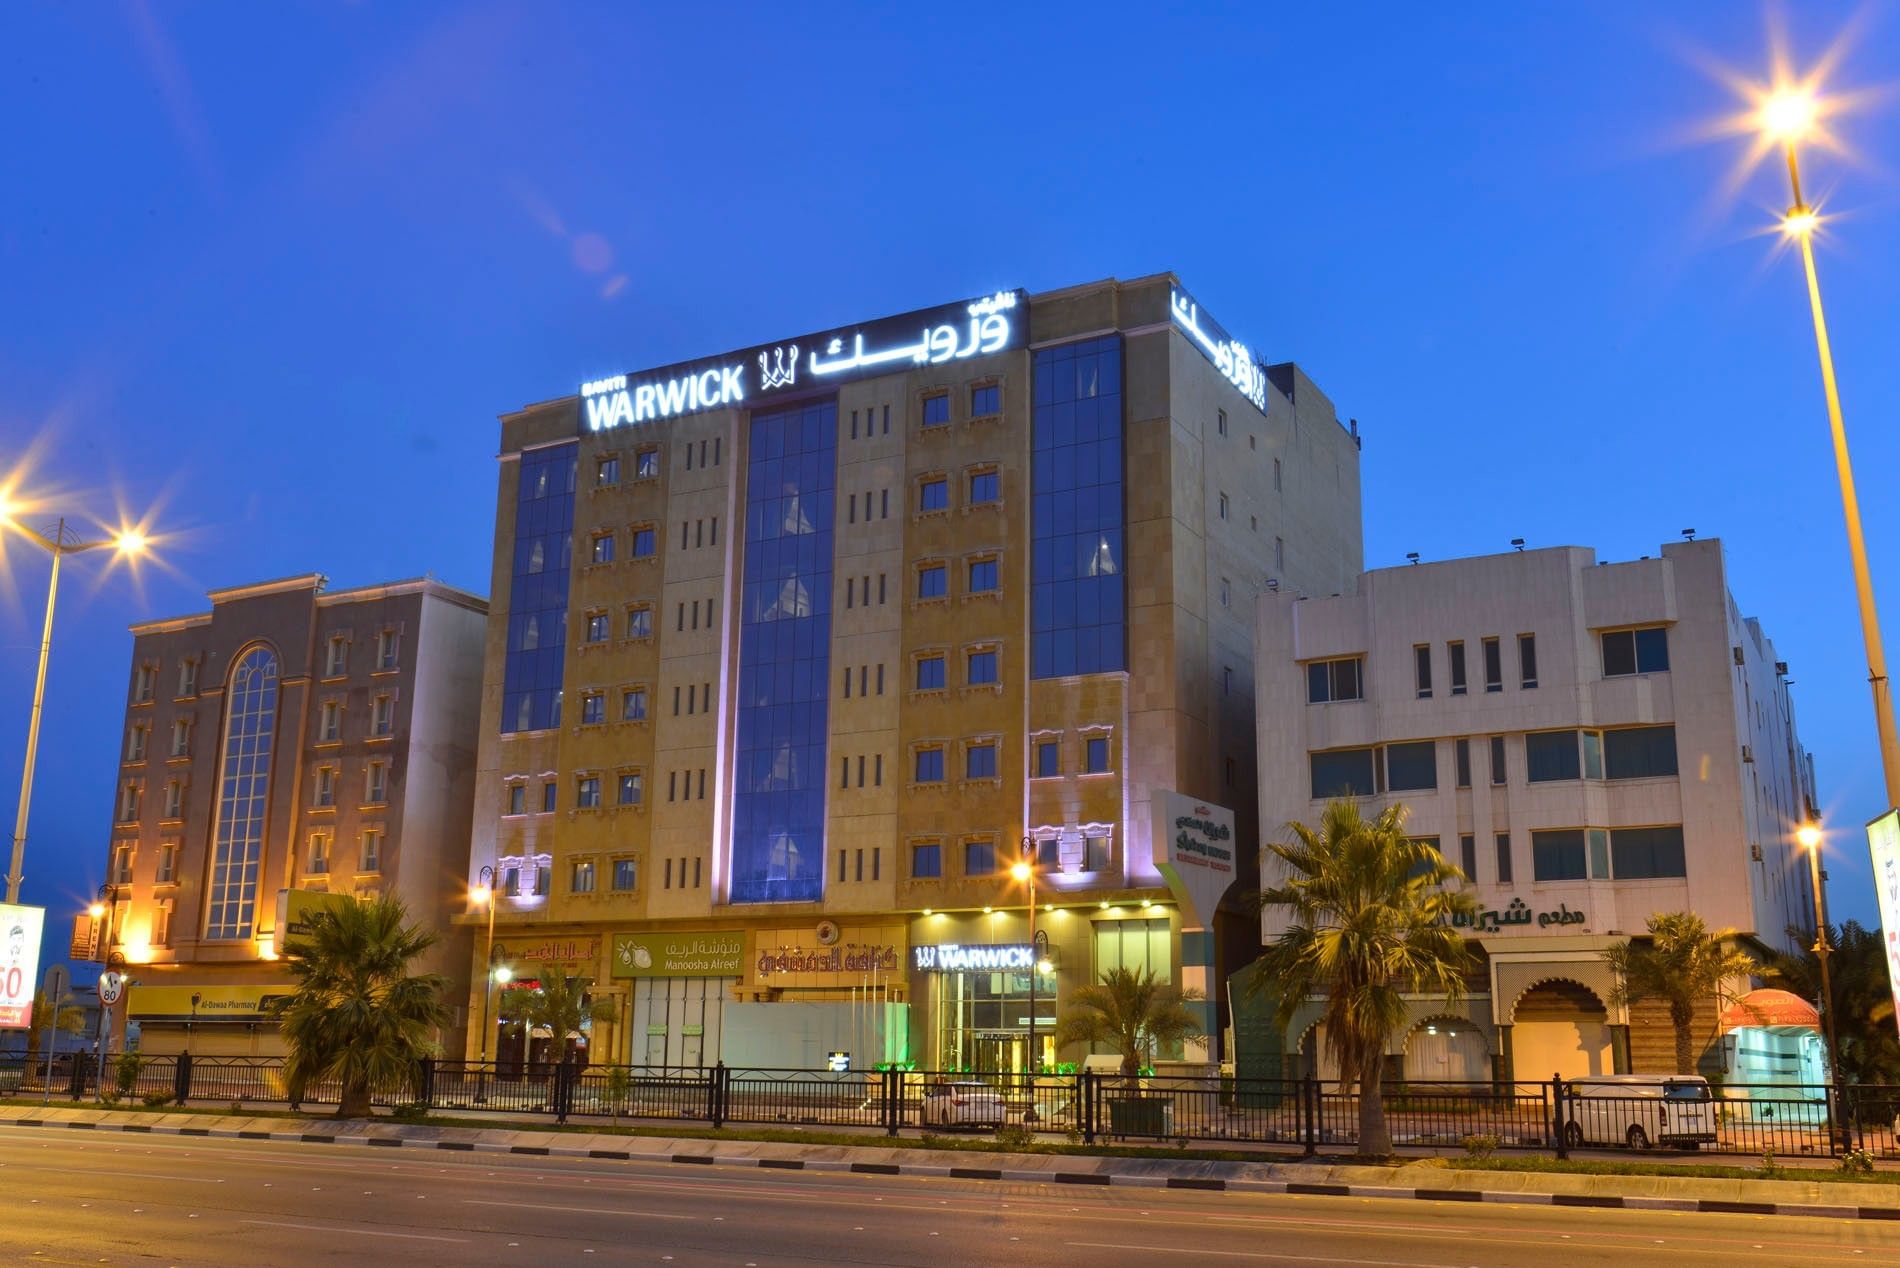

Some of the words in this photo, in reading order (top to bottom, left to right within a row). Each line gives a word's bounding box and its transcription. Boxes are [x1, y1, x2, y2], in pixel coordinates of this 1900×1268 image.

[587, 364, 744, 431] WARWICK
[1538, 903, 1586, 928] مطعم
[665, 960, 708, 970] Manoosha
[938, 947, 1034, 969] WARWICK
[104, 990, 116, 1001] 80
[228, 1000, 257, 1011] Pharmacy
